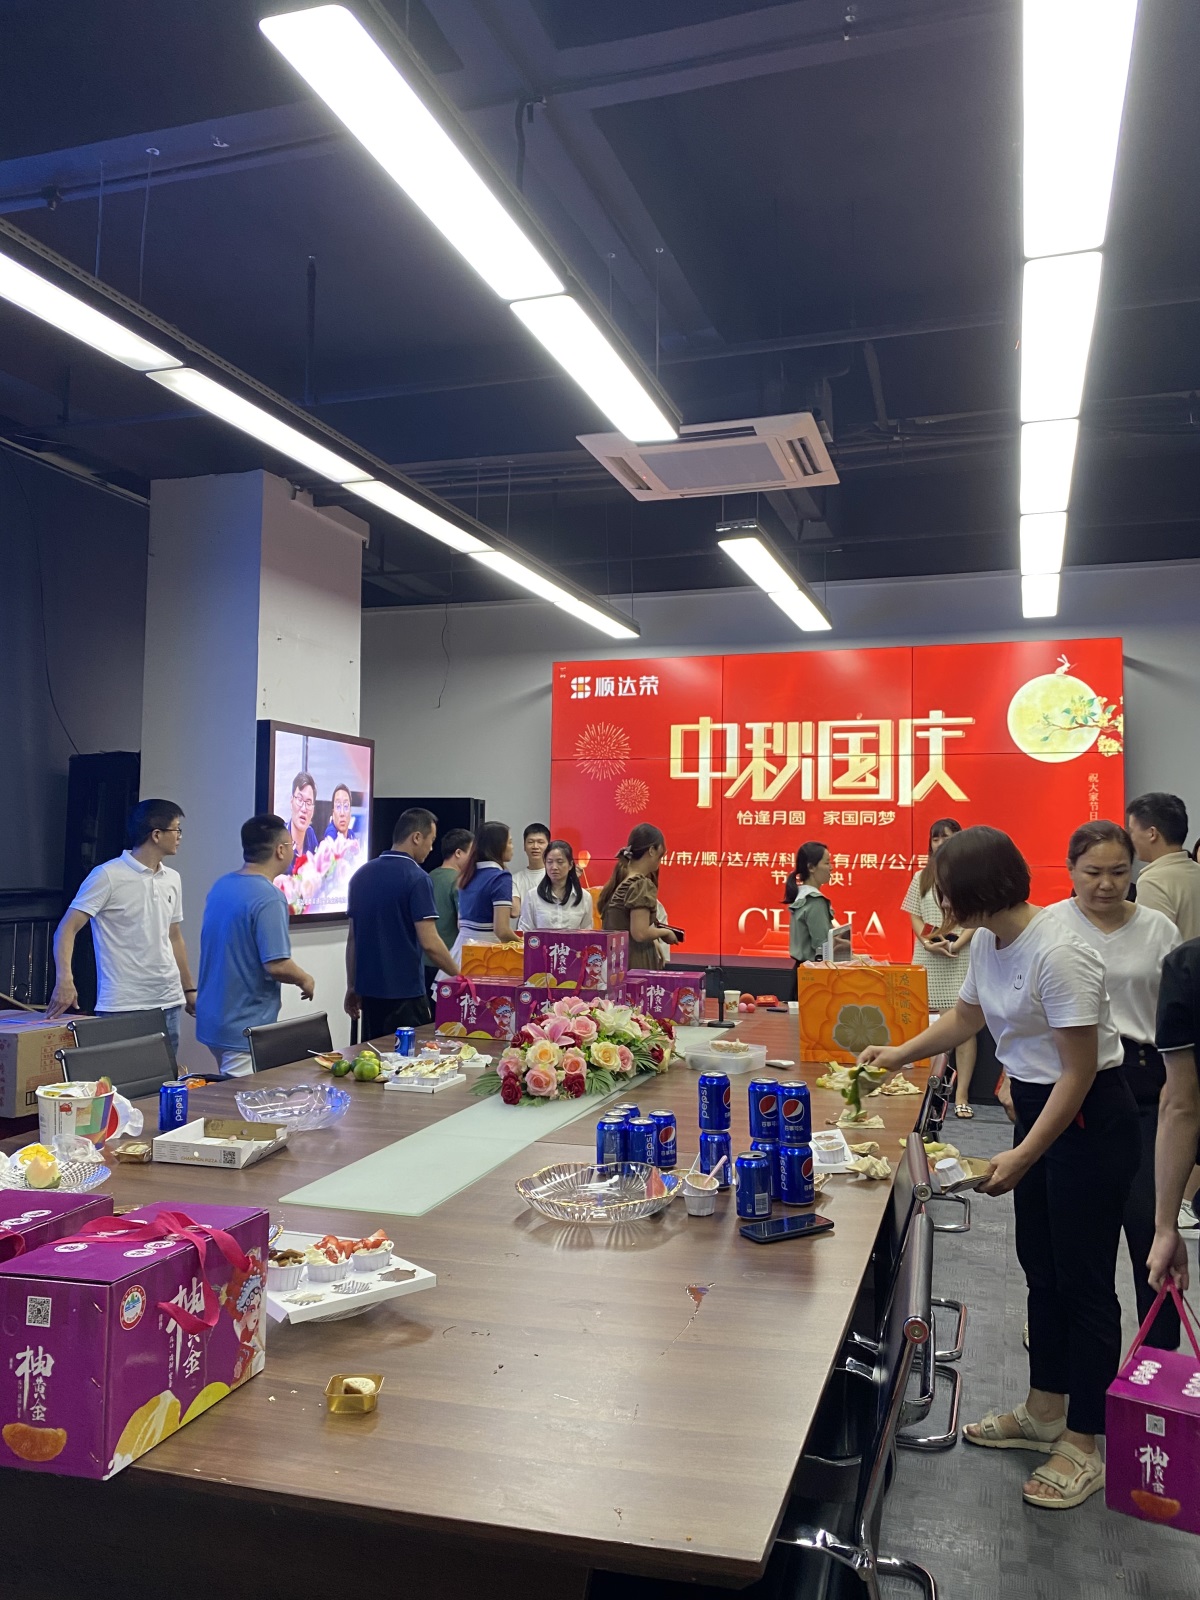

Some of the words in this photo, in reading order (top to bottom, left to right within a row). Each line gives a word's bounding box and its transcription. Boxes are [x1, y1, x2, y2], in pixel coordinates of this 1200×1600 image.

[594, 675, 659, 697] 顺达荣
[669, 710, 975, 808] 中秋国庆
[737, 811, 806, 826] 恰逢月圆
[823, 810, 896, 826] 家国同梦
[701, 1086, 709, 1119] pepsi
[645, 1133, 654, 1164] pepsi
[780, 1156, 788, 1191] pepsi
